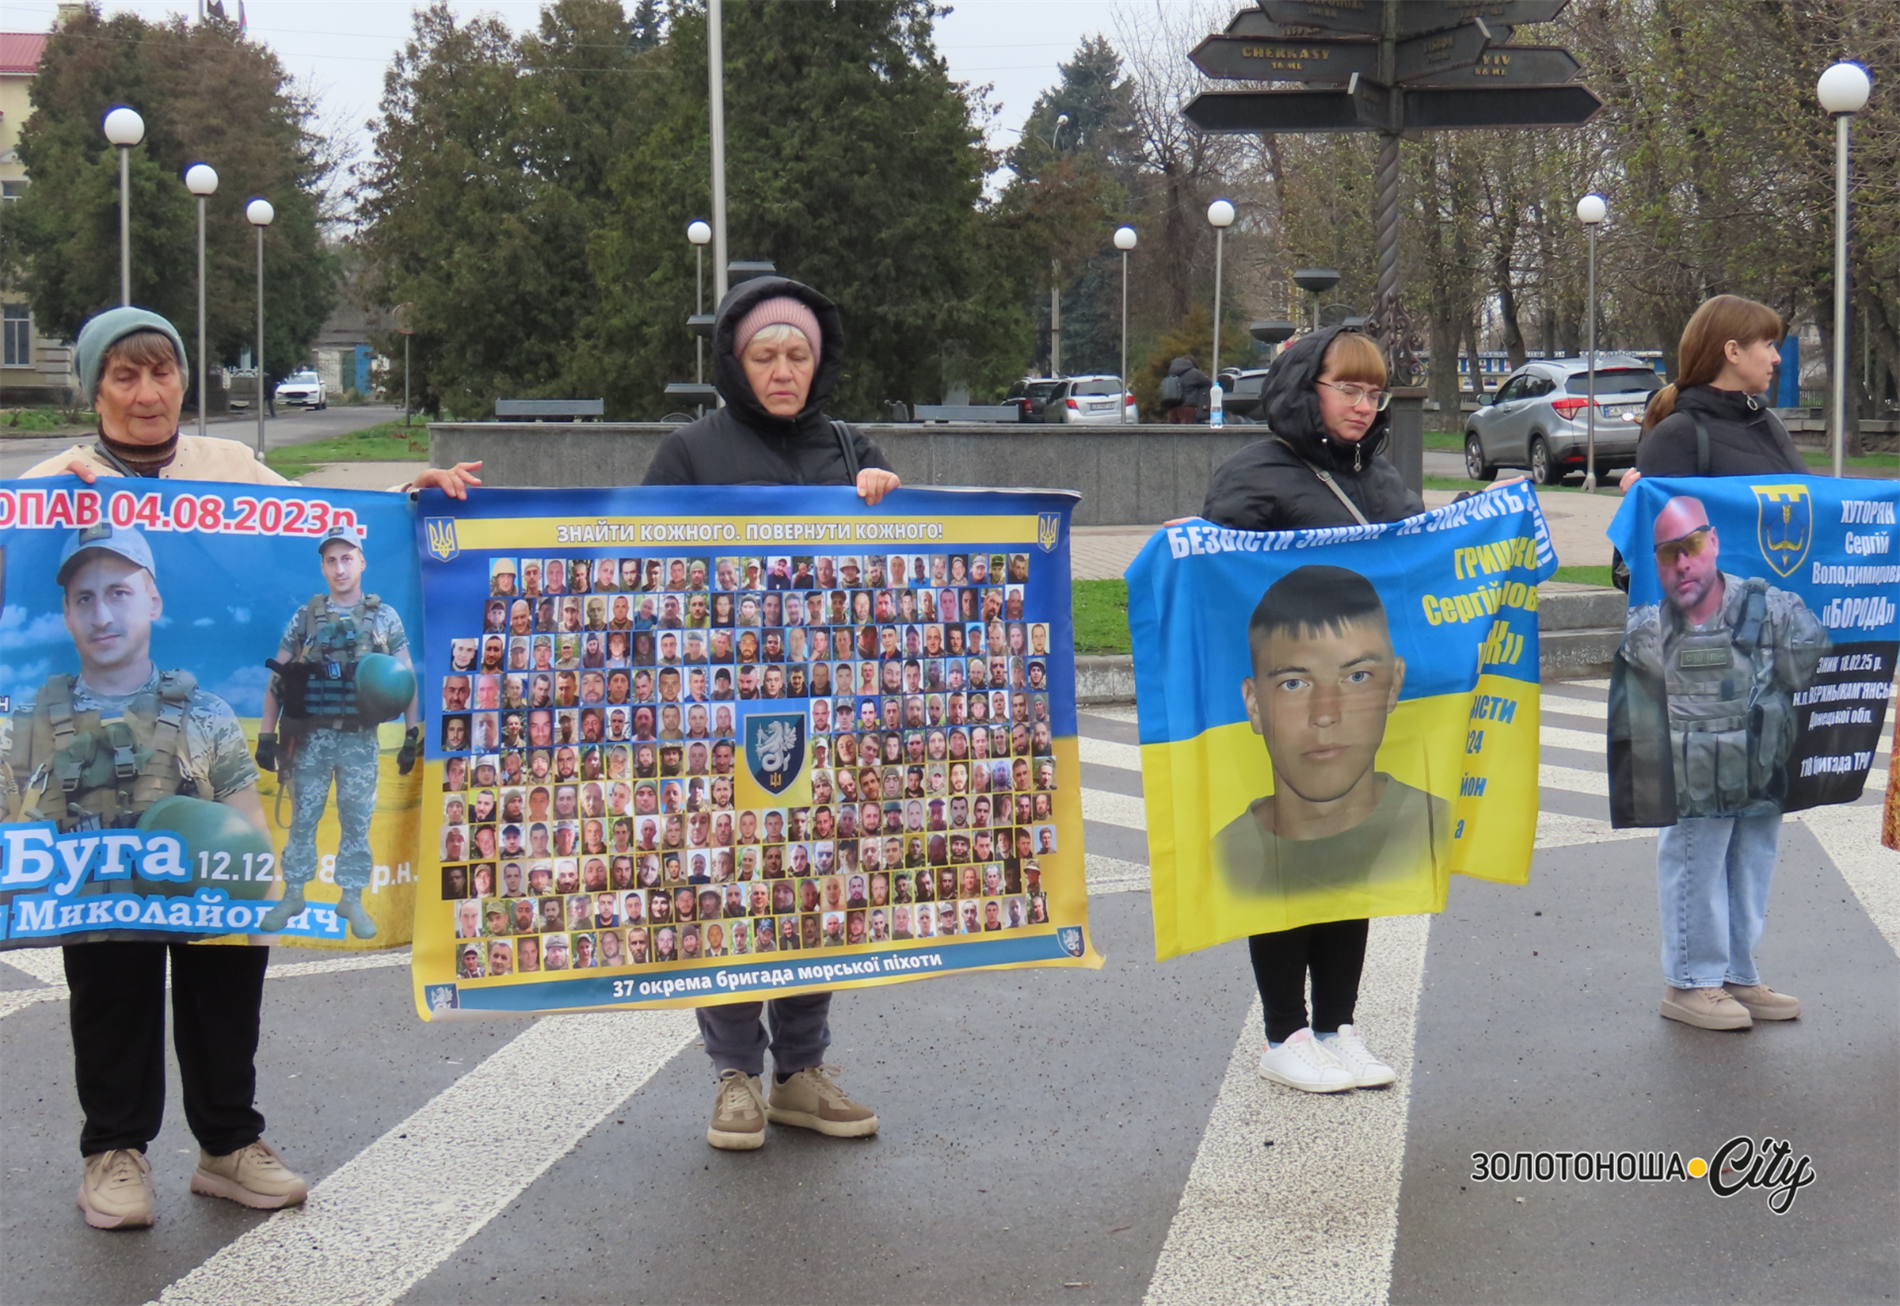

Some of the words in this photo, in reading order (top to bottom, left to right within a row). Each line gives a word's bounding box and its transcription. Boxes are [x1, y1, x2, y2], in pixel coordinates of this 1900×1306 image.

[1241, 47, 1330, 60] CHERKASY
[1482, 55, 1511, 66] YIV
[1166, 525, 1295, 560] БЕЗВІСТИ
[1396, 512, 1427, 536] НЕ
[1426, 488, 1524, 532] ЗНАЧИТЬ
[1840, 500, 1896, 524] ХУТОРЯН
[556, 519, 635, 543] ЗНАЙТИ
[639, 522, 741, 542] КОЖНОГО.
[745, 521, 851, 541] ПОВЕРНУТИ
[855, 521, 944, 540] КОЖНОГО!
[1844, 531, 1889, 556] Сергій
[1816, 656, 1839, 673] ЗНИК
[1808, 707, 1851, 731] Донецької
[1850, 707, 1872, 723] обл.
[1, 827, 187, 896] Буга
[612, 979, 635, 998] 37
[638, 975, 713, 998] окрема
[715, 969, 795, 995] бригада
[797, 958, 880, 983] морської
[883, 951, 943, 973] піхоти
